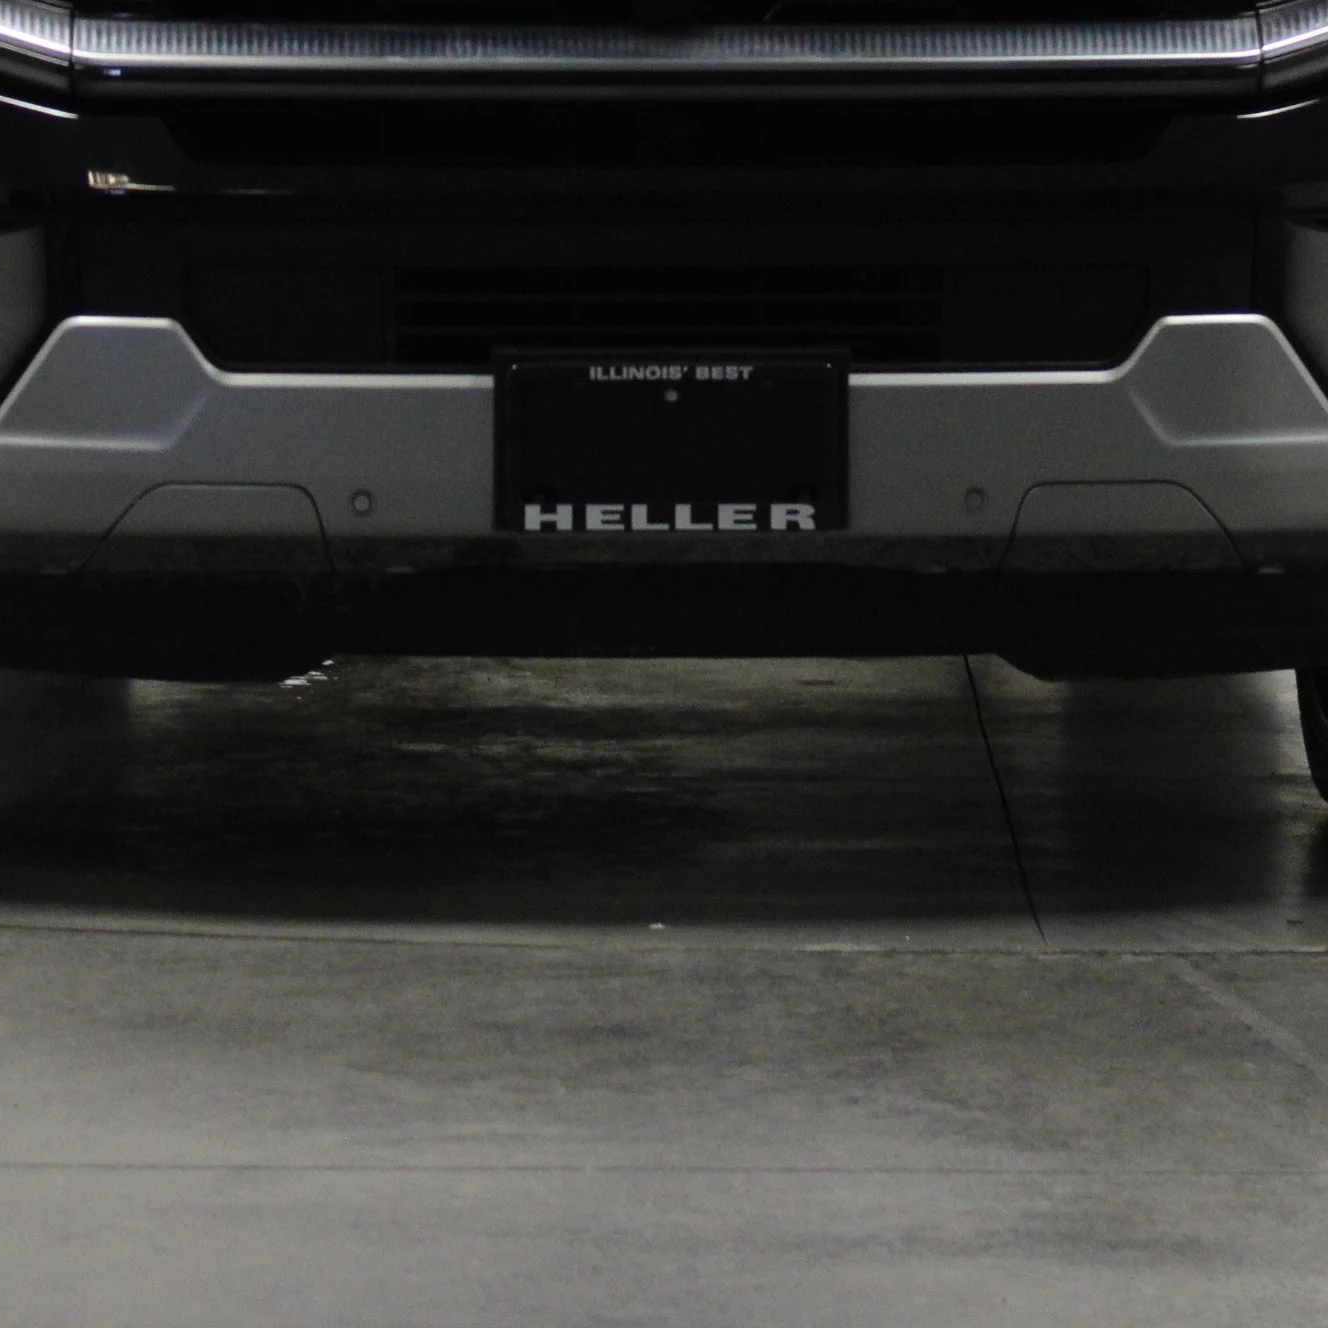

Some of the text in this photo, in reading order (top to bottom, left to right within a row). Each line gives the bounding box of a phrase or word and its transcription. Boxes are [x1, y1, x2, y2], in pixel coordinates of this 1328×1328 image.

[589, 365, 753, 381] ILLINOIS' BEST
[523, 502, 817, 531] HELLER
